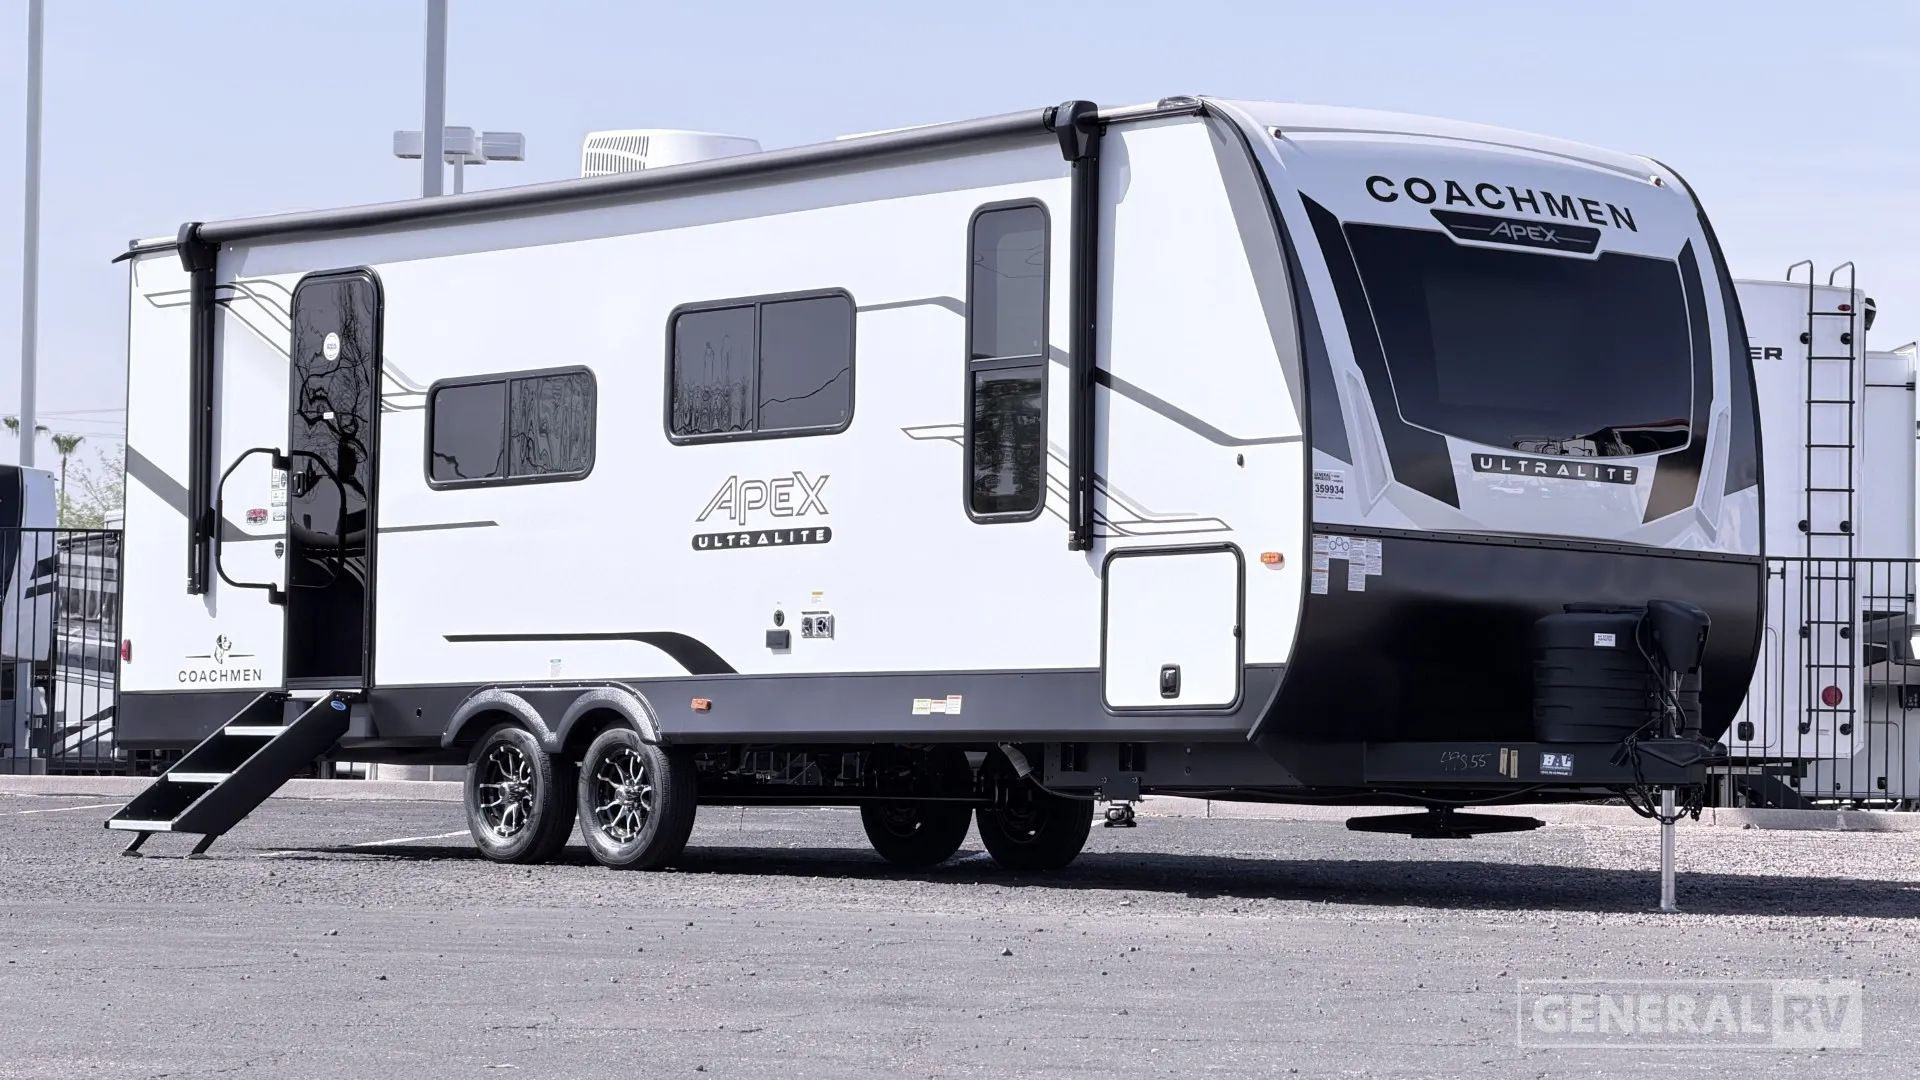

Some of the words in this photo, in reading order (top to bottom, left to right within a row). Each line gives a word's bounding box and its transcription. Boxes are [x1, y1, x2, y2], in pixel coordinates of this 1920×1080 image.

[1365, 175, 1638, 232] COACHMEN
[1489, 221, 1560, 243] APEX
[1480, 457, 1632, 481] ULTRALITE
[695, 470, 830, 526] APEX
[1314, 484, 1344, 494] 359934
[698, 529, 825, 548] ULTRALITE
[178, 669, 262, 682] COACHMEN
